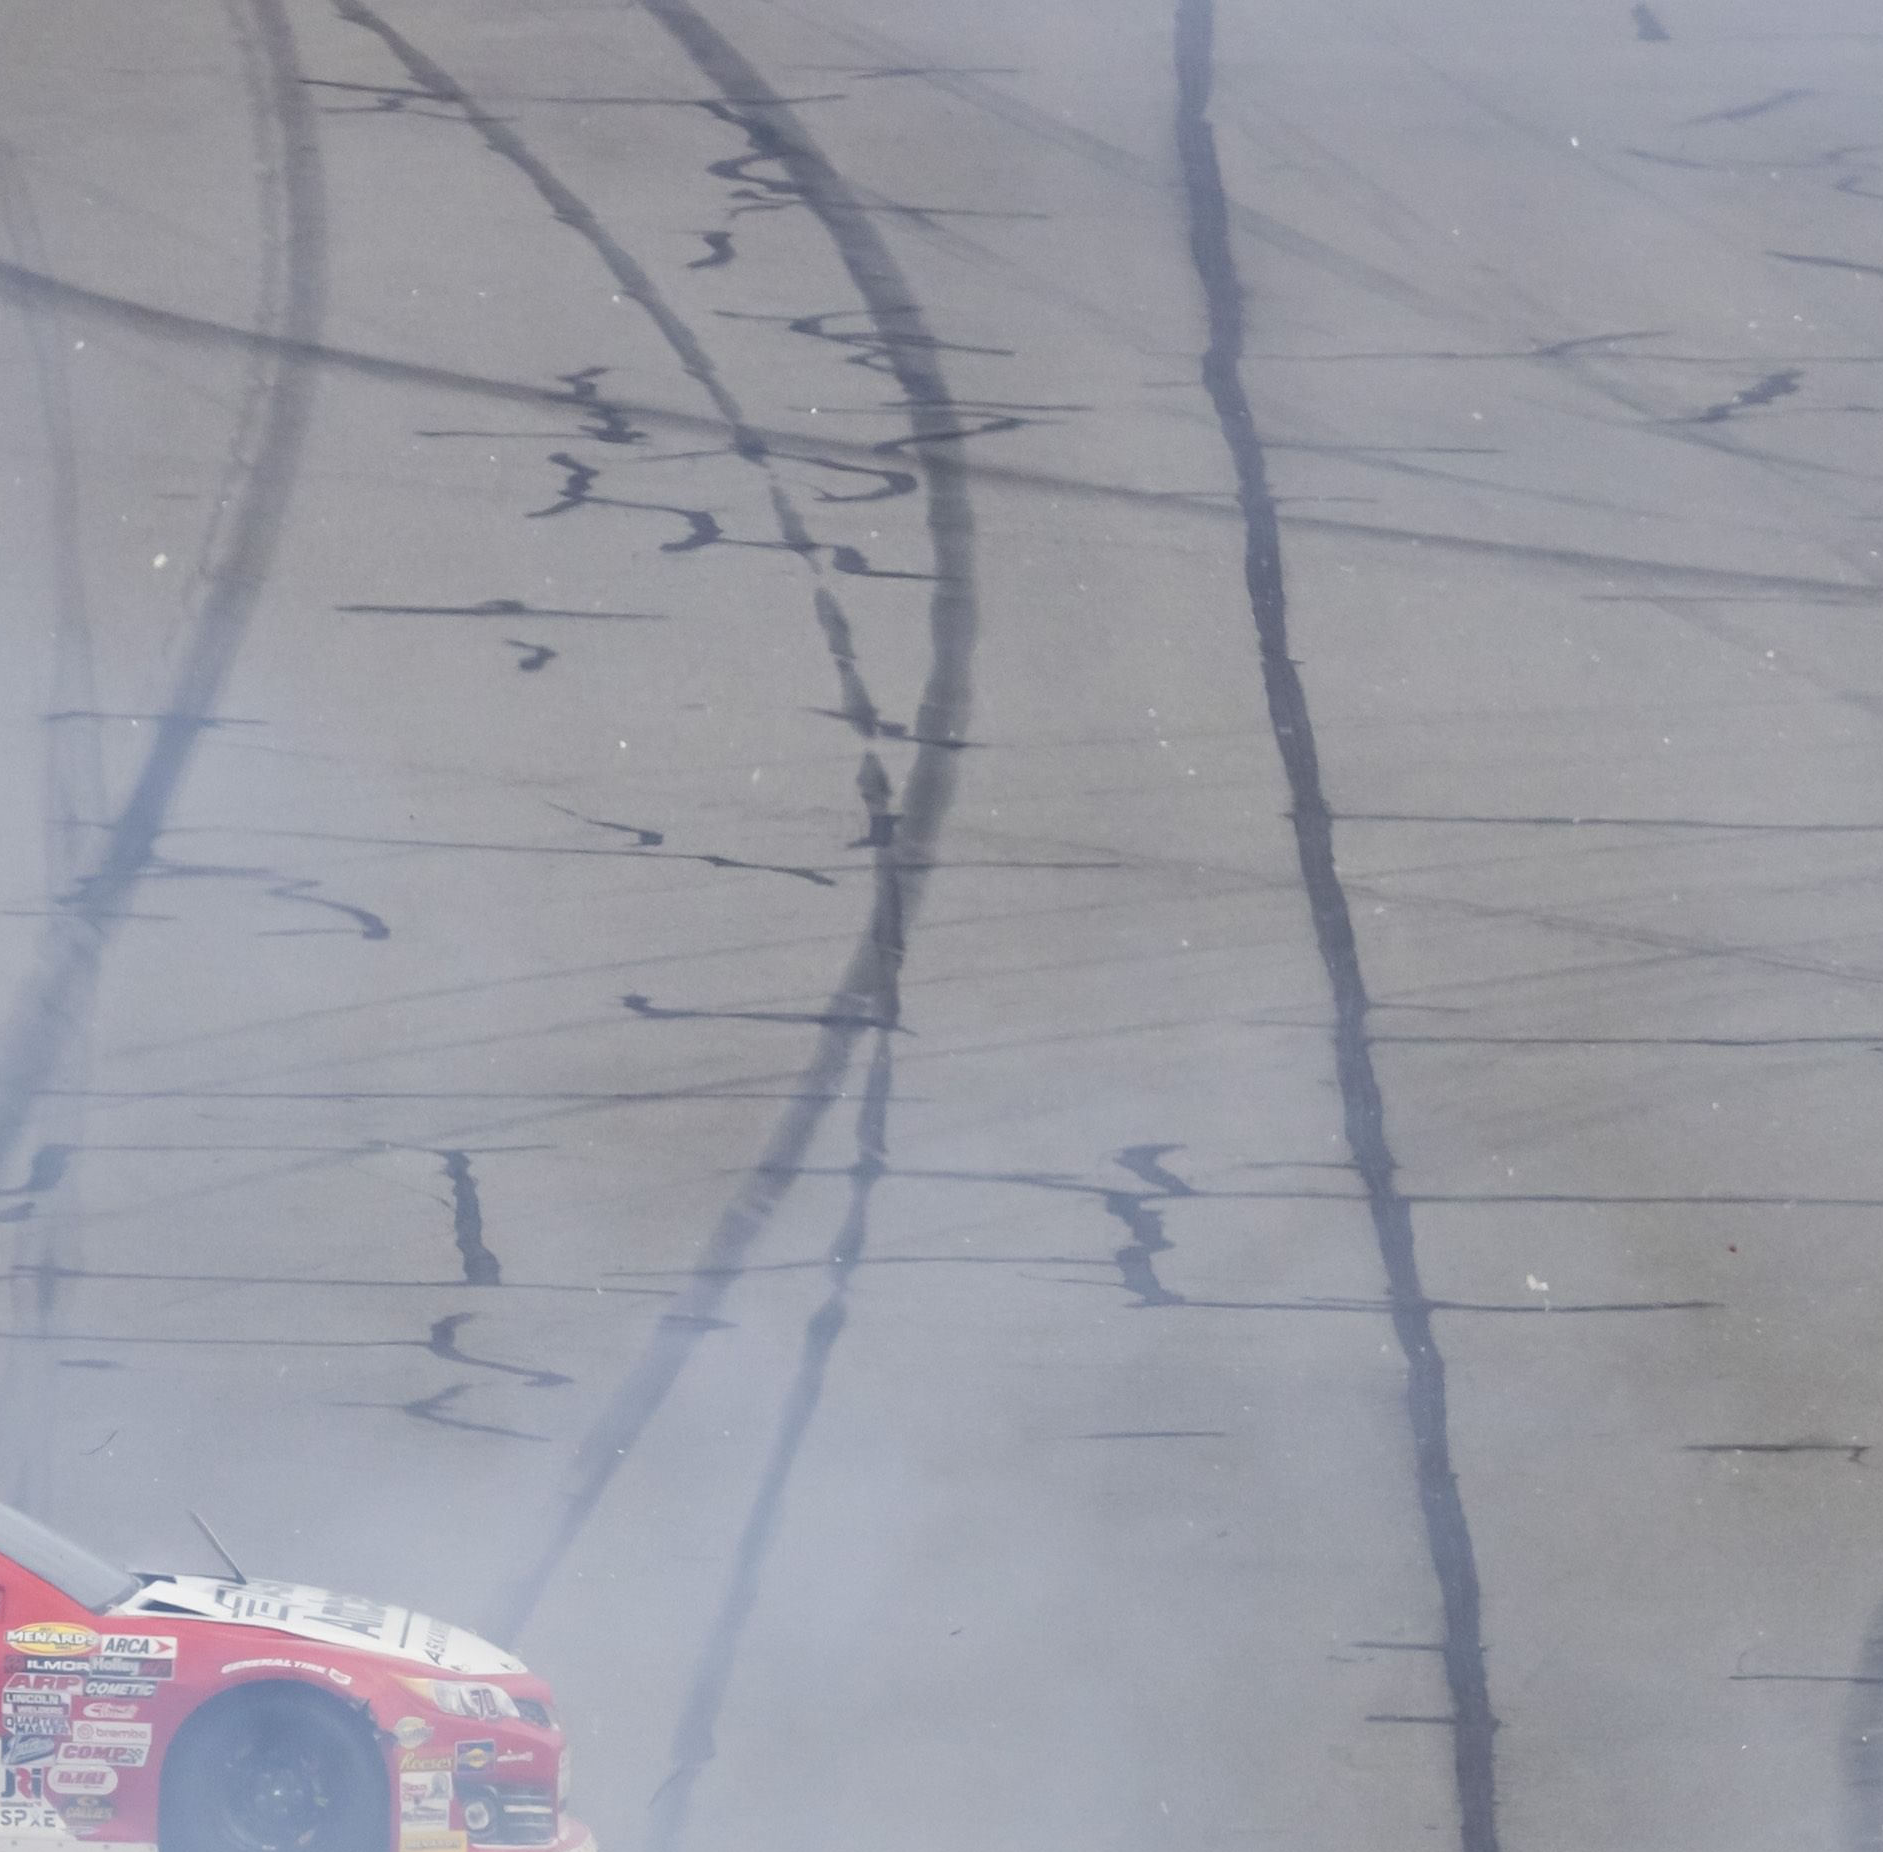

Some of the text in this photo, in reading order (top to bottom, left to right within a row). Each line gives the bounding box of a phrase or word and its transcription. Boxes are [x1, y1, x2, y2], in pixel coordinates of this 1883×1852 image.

[6, 1630, 100, 1647] MENARDS
[104, 1637, 150, 1654] ARCA
[27, 1660, 90, 1671] ILMOR
[7, 1674, 80, 1691] ARP
[86, 1681, 155, 1695] COMETIC
[6, 1693, 59, 1704] LINCOLN
[96, 1728, 148, 1740] brembo
[62, 1744, 128, 1759] COMP
